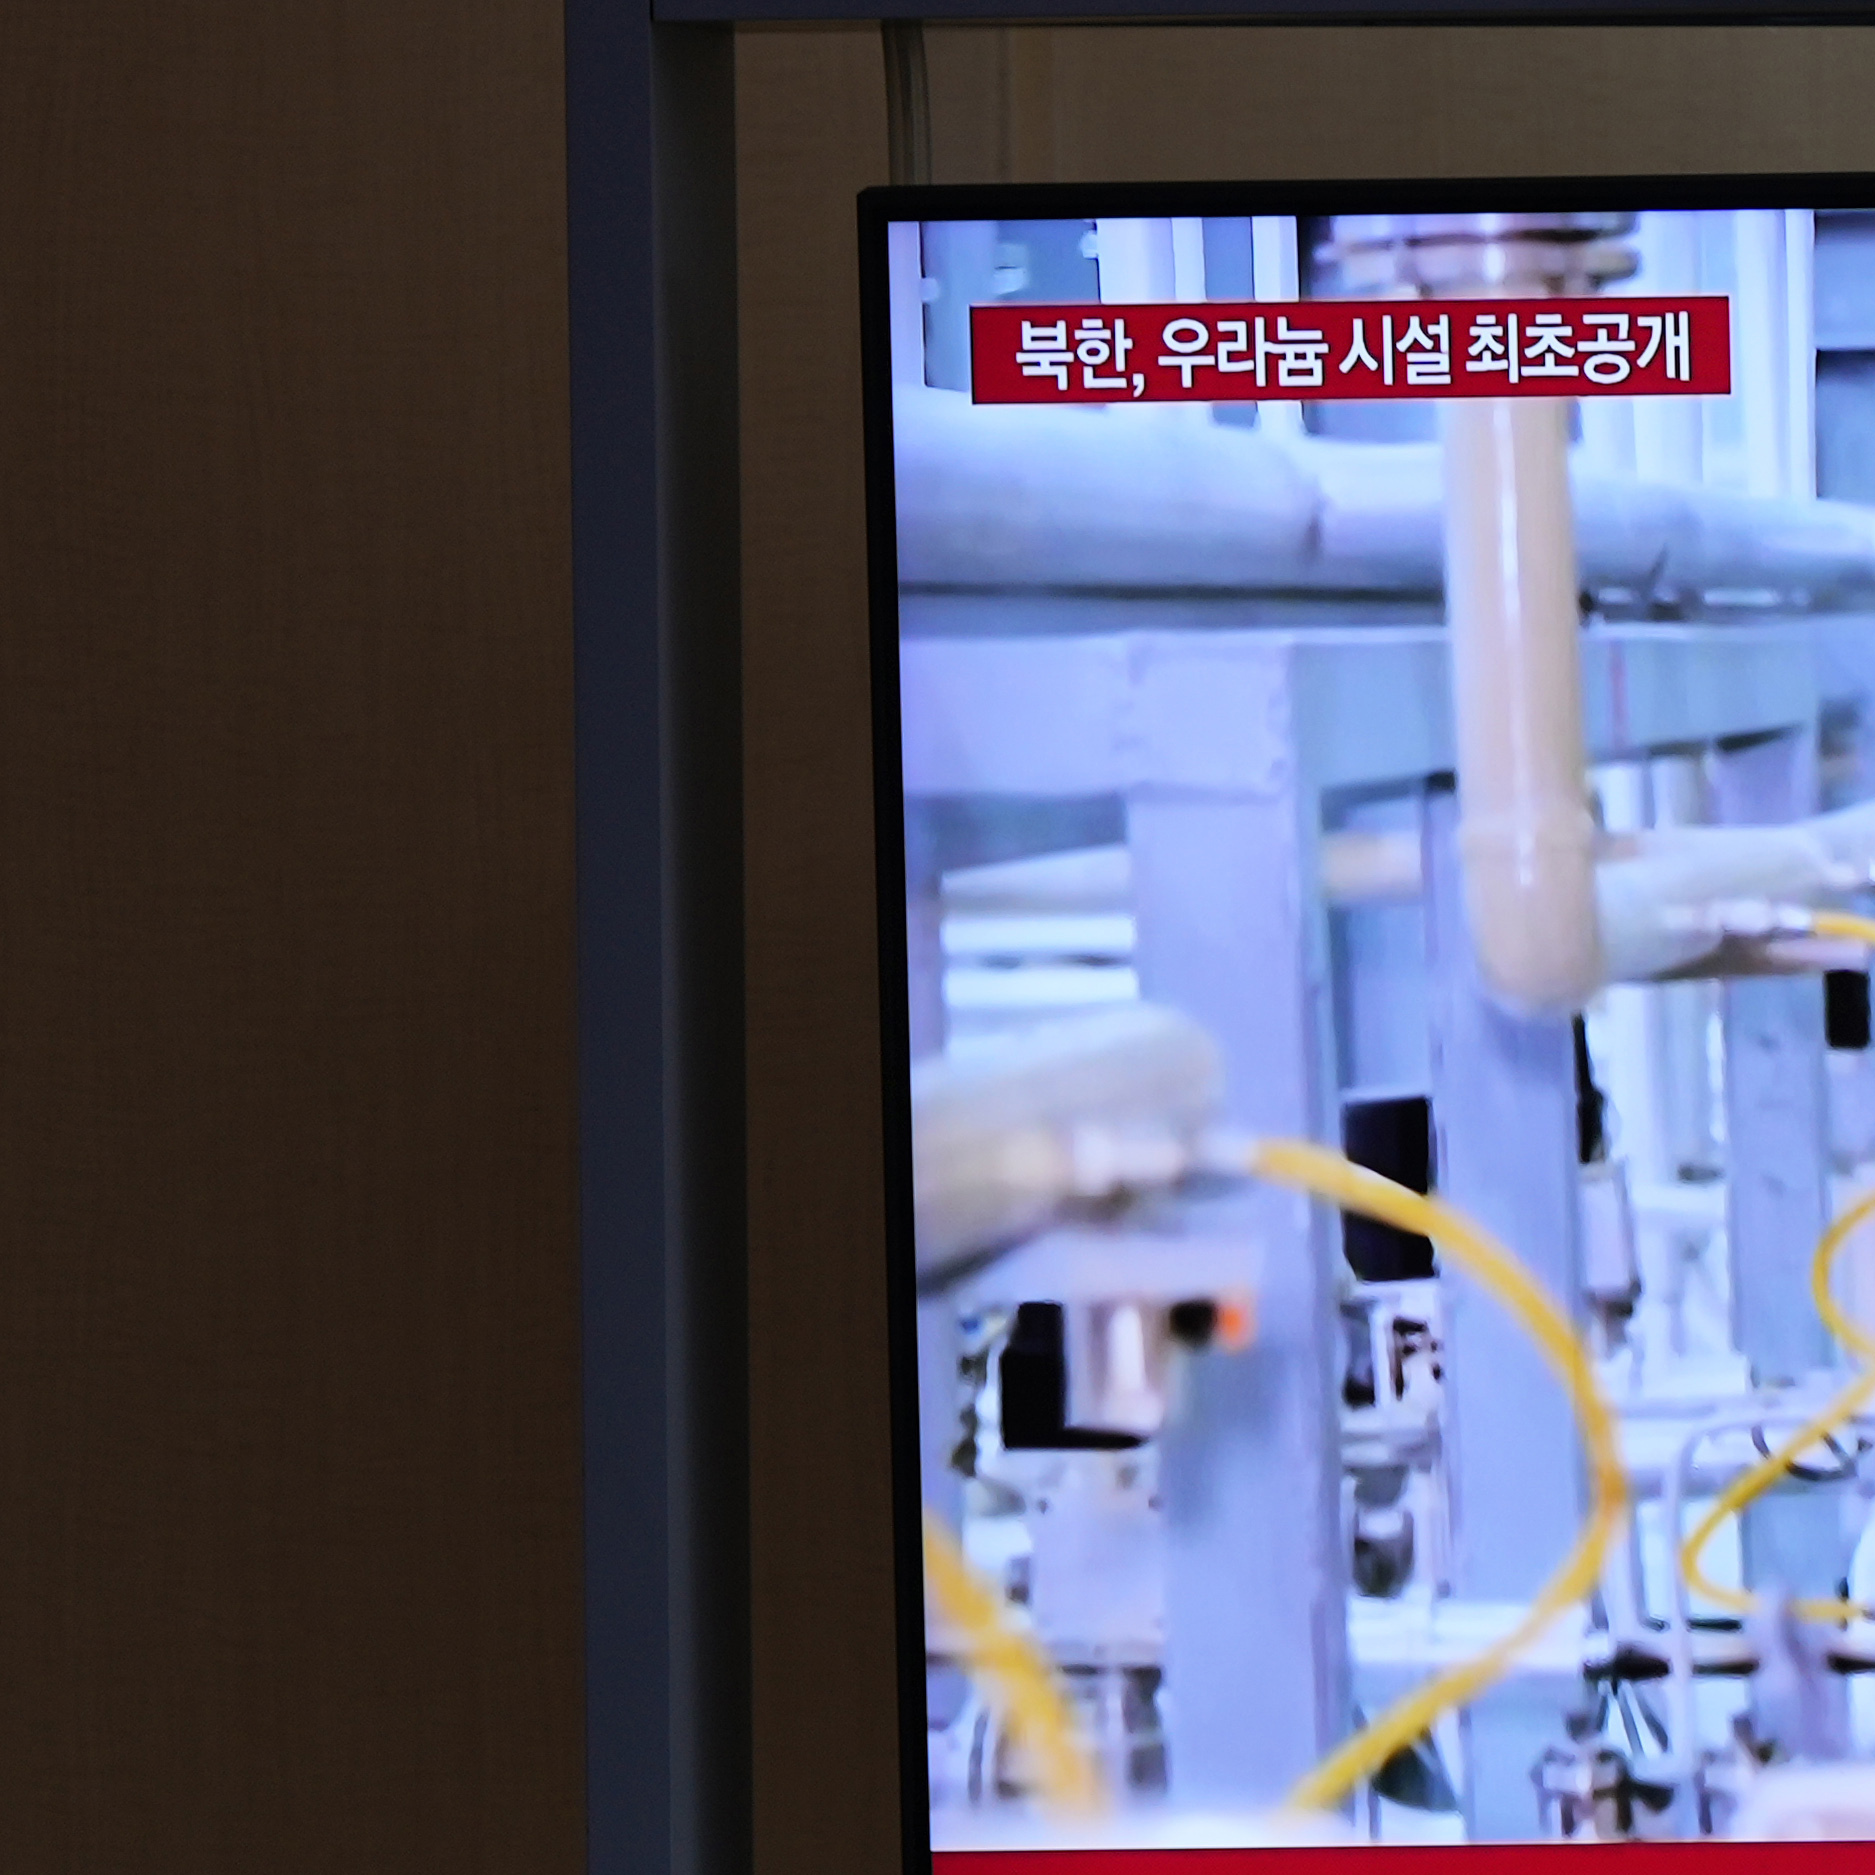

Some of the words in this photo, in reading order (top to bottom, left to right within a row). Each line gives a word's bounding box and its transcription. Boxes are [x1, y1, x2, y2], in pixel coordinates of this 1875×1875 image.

[1015, 319, 1146, 397] 북한,
[1157, 316, 1330, 389] 우라늄
[1340, 311, 1452, 386] 시설
[1465, 310, 1691, 385] 최초공개
